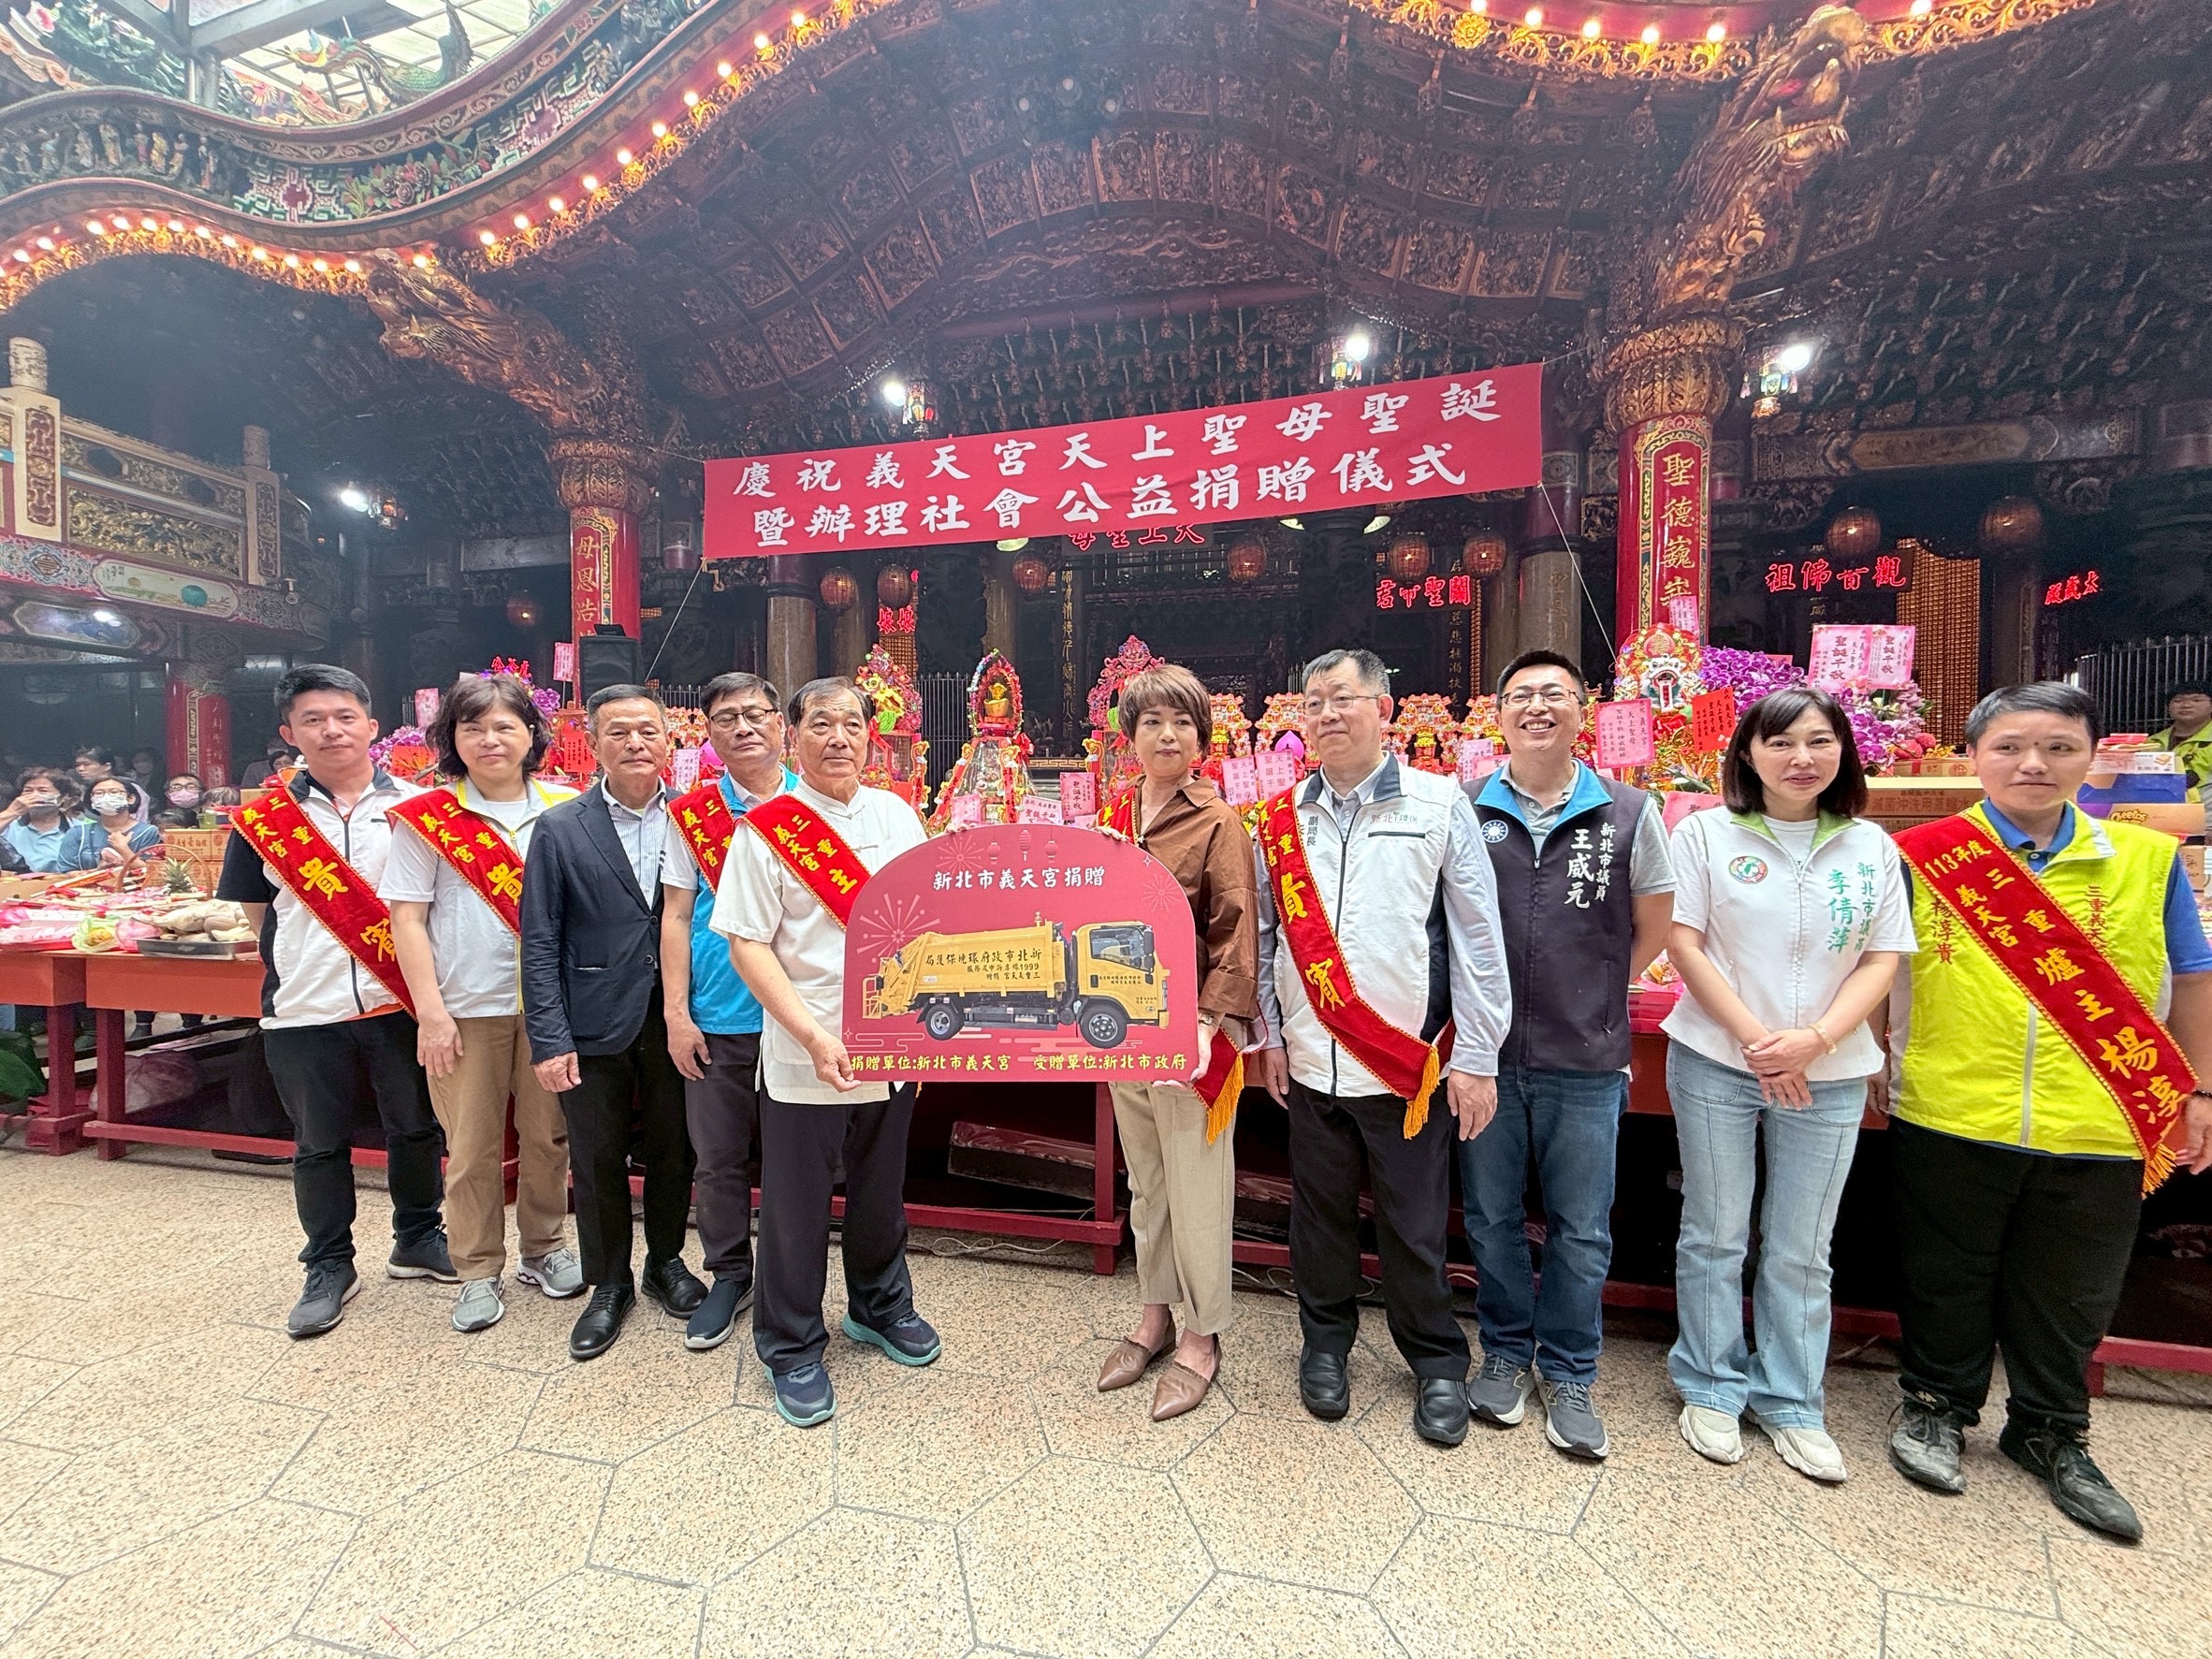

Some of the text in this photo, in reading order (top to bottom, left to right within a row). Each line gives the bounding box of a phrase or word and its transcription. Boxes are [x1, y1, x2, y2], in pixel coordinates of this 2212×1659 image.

[733, 379, 1501, 497] 慶祝義天宮天上聖母聖誕
[751, 442, 1466, 547] 暨辦理社會公益捐贈儀式
[575, 535, 601, 639] 母恩浩
[1828, 635, 1848, 680] 聖誕千秋
[1881, 635, 1895, 674] 聖誕千秋
[1274, 755, 1286, 793] 天上聖
[241, 807, 289, 859] 義天宮
[269, 796, 314, 846] 三重
[418, 811, 475, 864] 義天宮
[442, 802, 499, 850] 三重
[680, 807, 719, 868] 義天宮
[791, 814, 838, 859] 三重
[1273, 796, 1295, 856] 三重
[1306, 815, 1318, 847] 副局長
[2109, 809, 2149, 822] Cheetos
[771, 823, 821, 871] 義天宮
[1564, 828, 1594, 910] 王威元
[1594, 822, 1617, 902] 新北市議員
[1924, 839, 1992, 880] 113年度
[933, 866, 1105, 890] 新北市義天宮捐贈
[1986, 867, 2057, 933] 三重
[1826, 868, 1858, 954] 李倩萍
[1930, 896, 1957, 965] 楊淳貴
[1955, 884, 2019, 948] 義天宮
[1279, 870, 1346, 1012] 貴賓
[2032, 946, 2115, 1023] 爐主
[851, 1054, 1187, 1071] 捐贈單位:新北市義天宮 受贈單位:新北市政府
